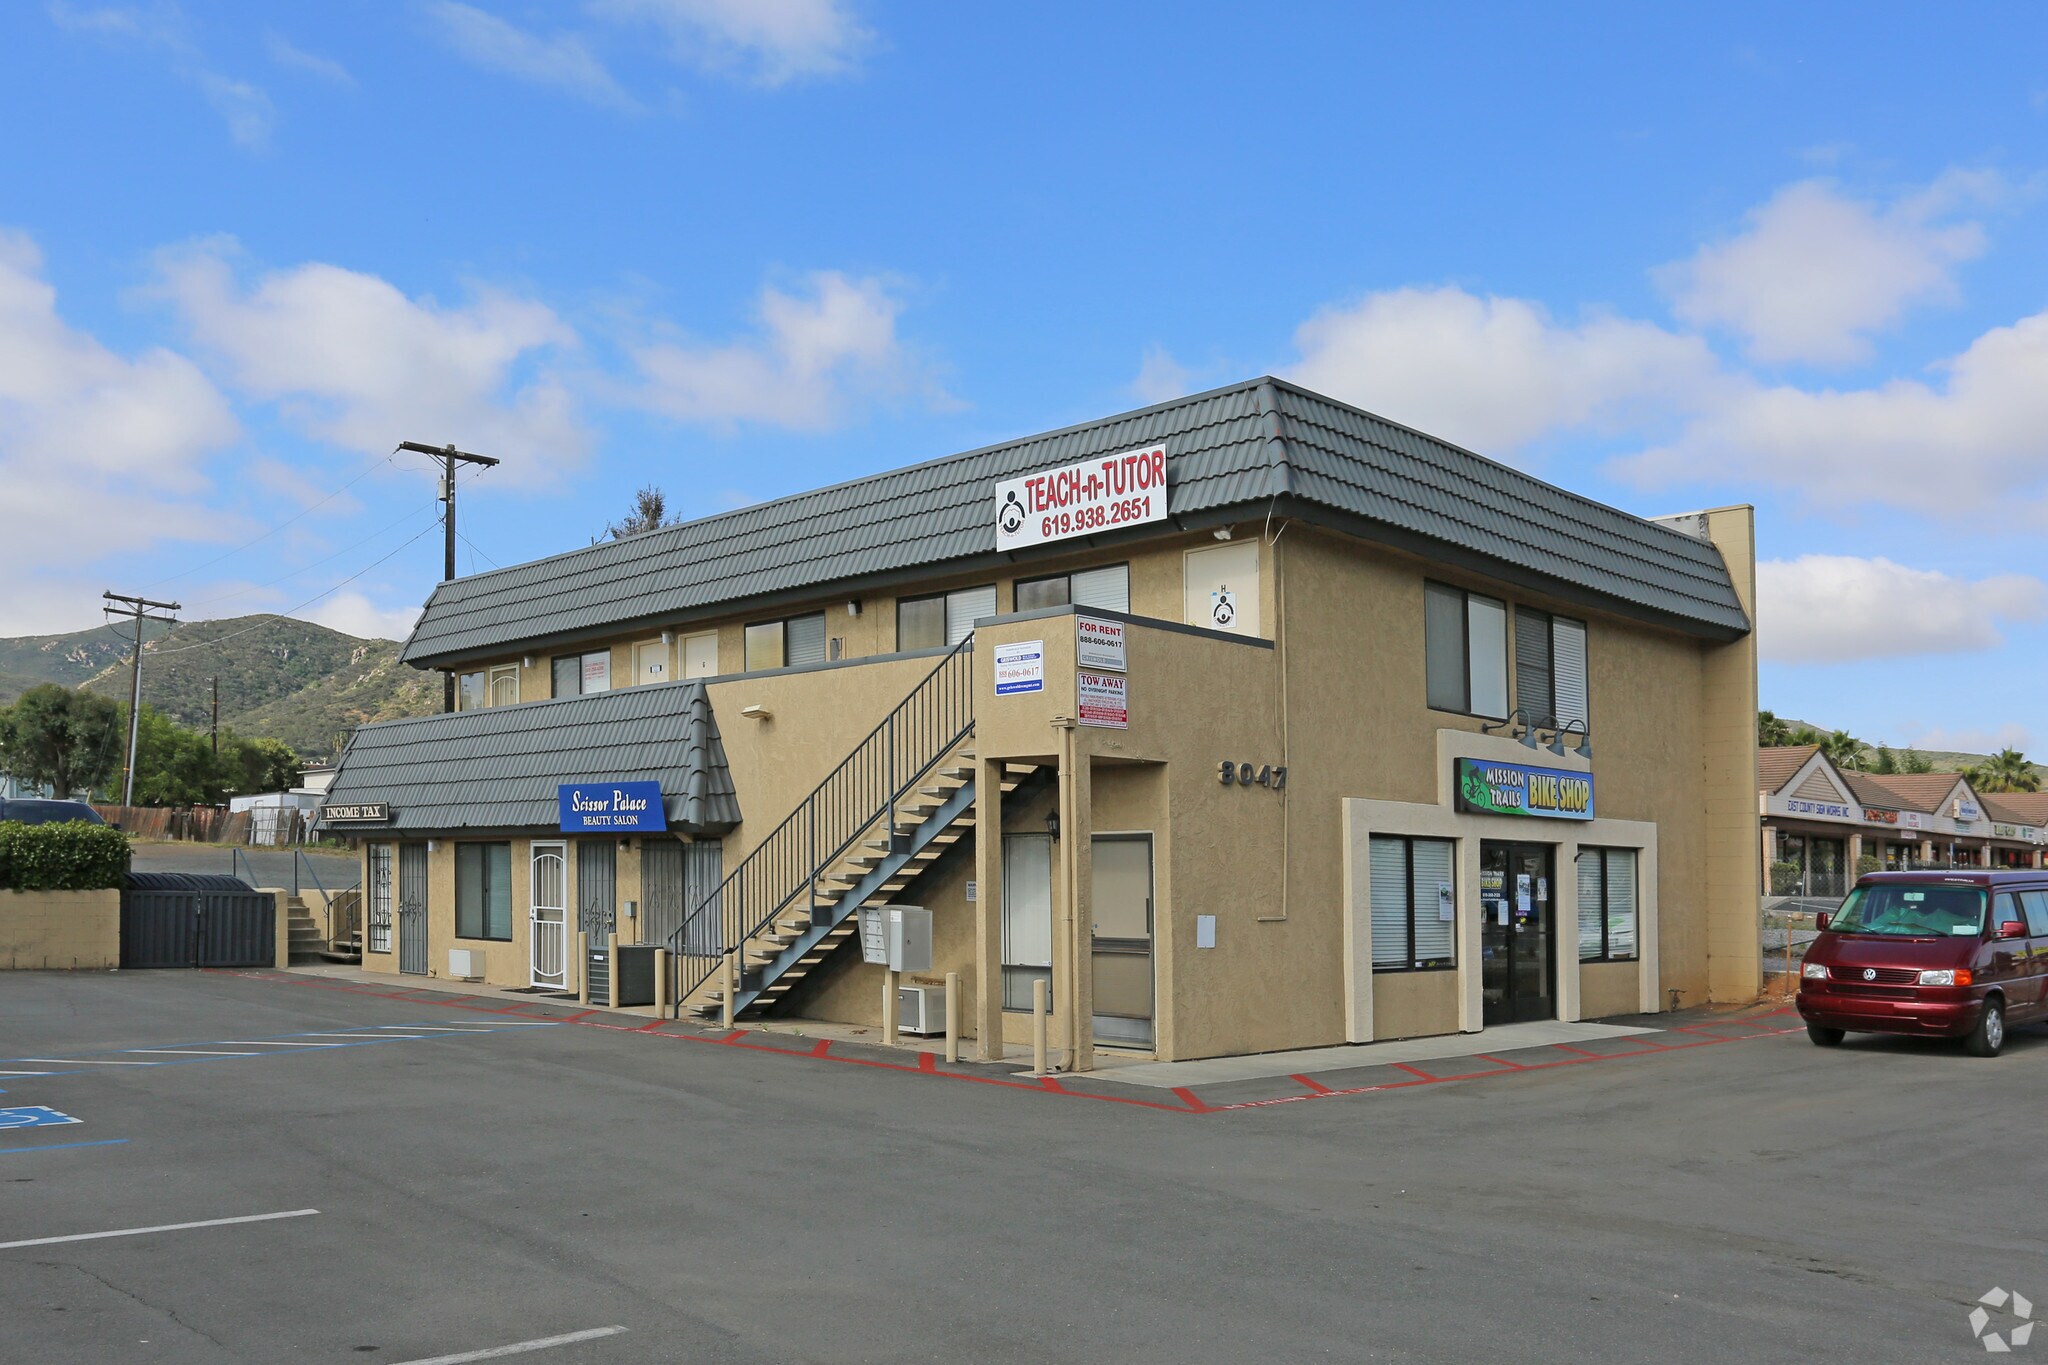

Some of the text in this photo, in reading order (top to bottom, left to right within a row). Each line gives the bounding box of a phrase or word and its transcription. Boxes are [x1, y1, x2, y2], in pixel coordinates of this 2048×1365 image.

[1025, 450, 1165, 514] TEACH-n-TUTOR
[1041, 495, 1151, 538] 619.938.2651
[1080, 622, 1121, 636] FOR RENT
[1080, 635, 1123, 648] 888-606-0617
[1007, 666, 1040, 679] 606-0617
[1081, 675, 1124, 689] TOW AWAY
[1217, 760, 1287, 789] 8047
[1485, 767, 1525, 789] MISSION
[572, 790, 647, 812] Scissor Palace
[1490, 788, 1521, 808] TRAILS
[1528, 772, 1590, 814] BIKE SHOP
[326, 806, 380, 818] INCOME TAX
[583, 815, 638, 825] BEAUTY SALON
